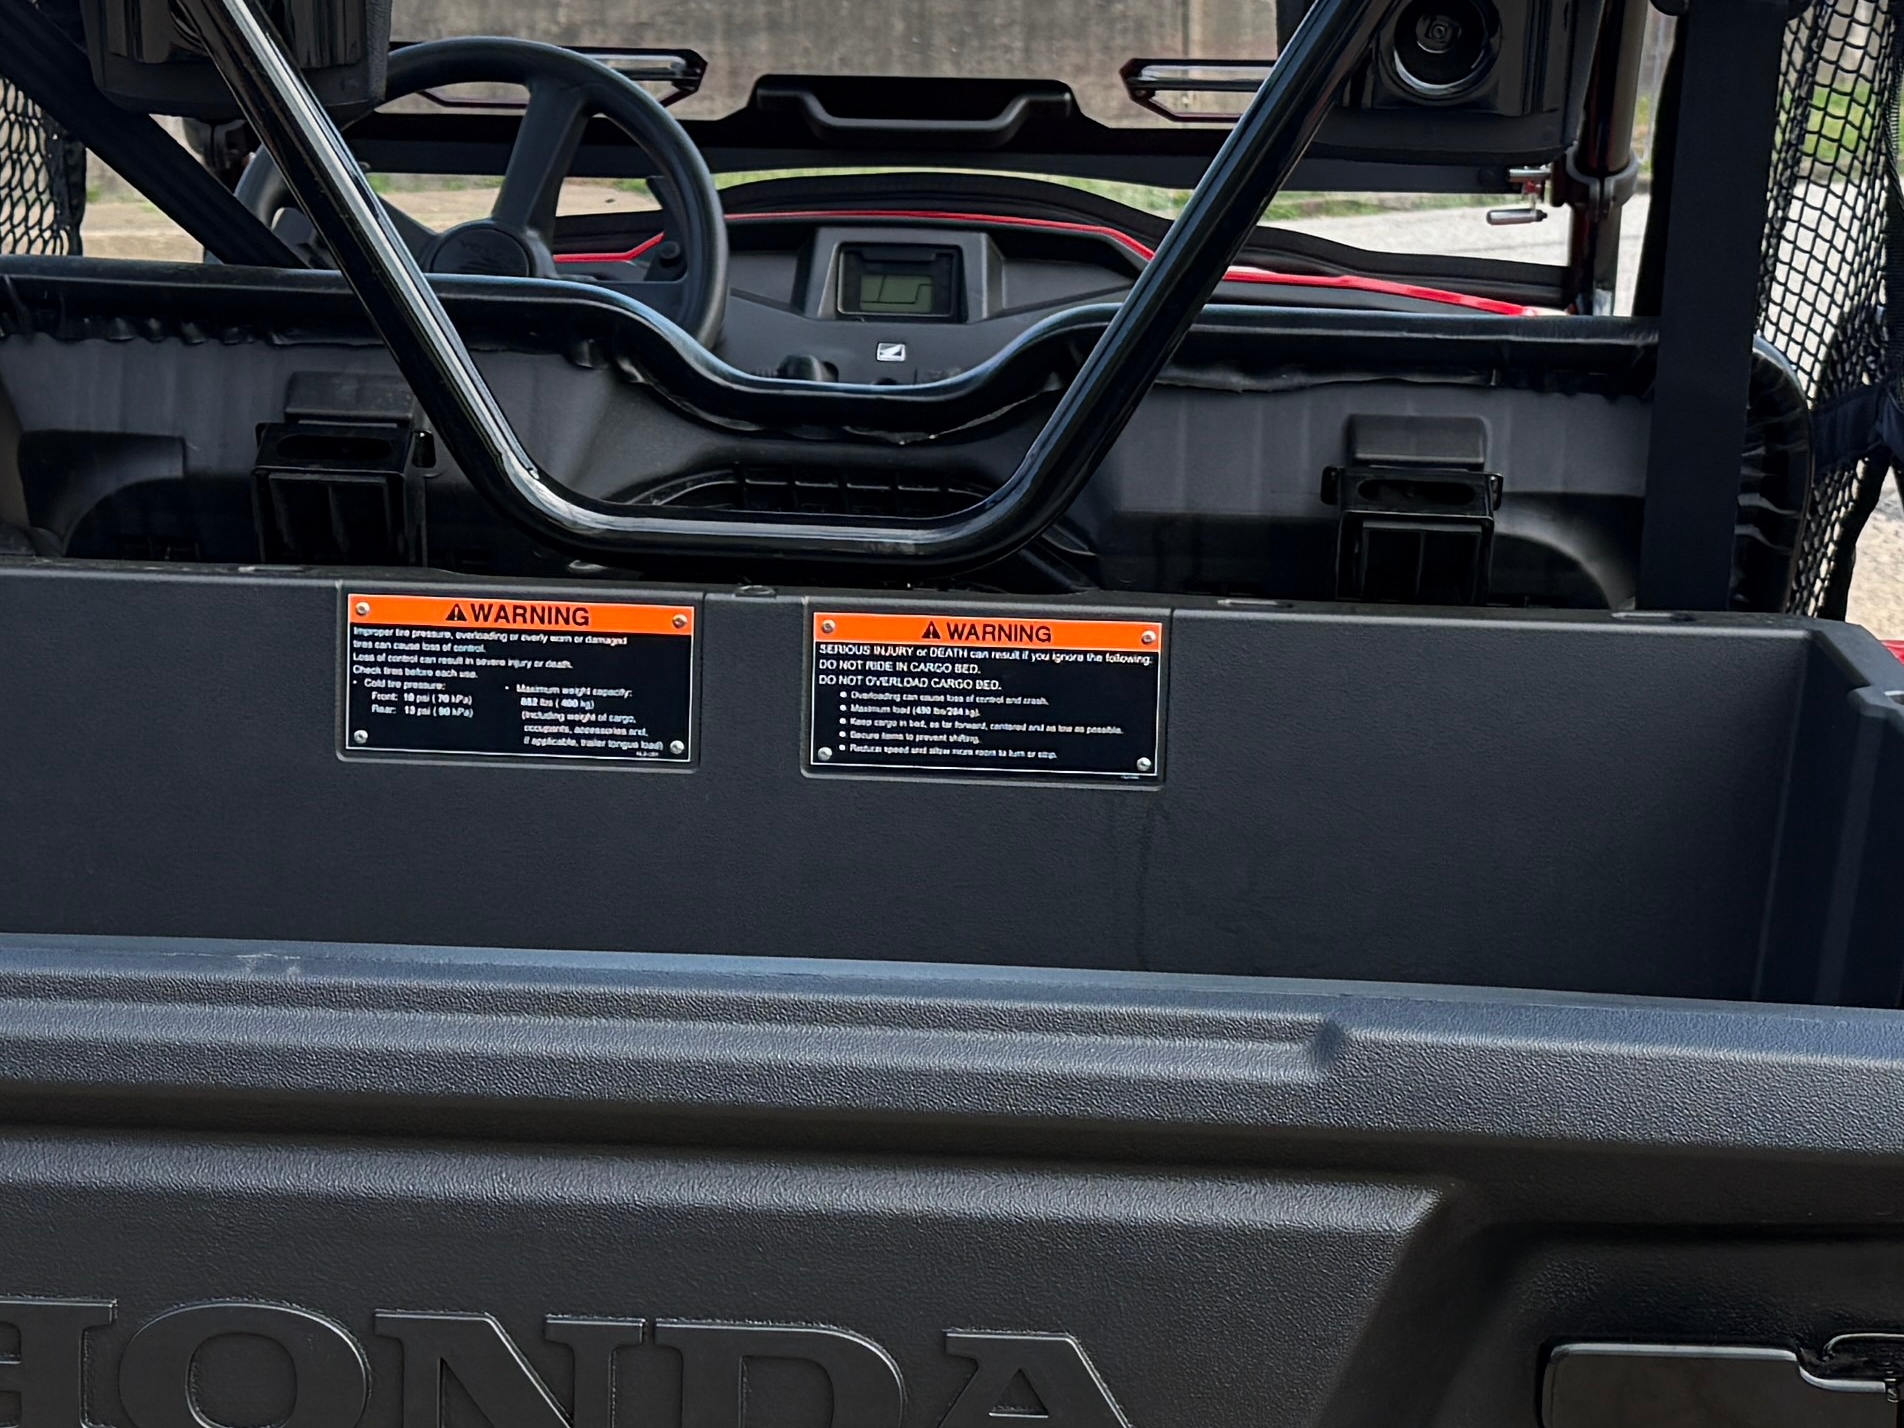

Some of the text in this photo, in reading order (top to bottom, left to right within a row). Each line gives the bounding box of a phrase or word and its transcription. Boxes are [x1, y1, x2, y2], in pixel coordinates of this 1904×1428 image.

[470, 603, 590, 626] WARNING
[946, 622, 1052, 643] WARNING
[819, 644, 1152, 665] SERIOUS INJURY or DEATH can result if you ignore the following.
[818, 659, 980, 674] DO NOT RIDE IN CARGO BED.
[818, 674, 1002, 690] DO NOT OVERLOAD CARGO BED.
